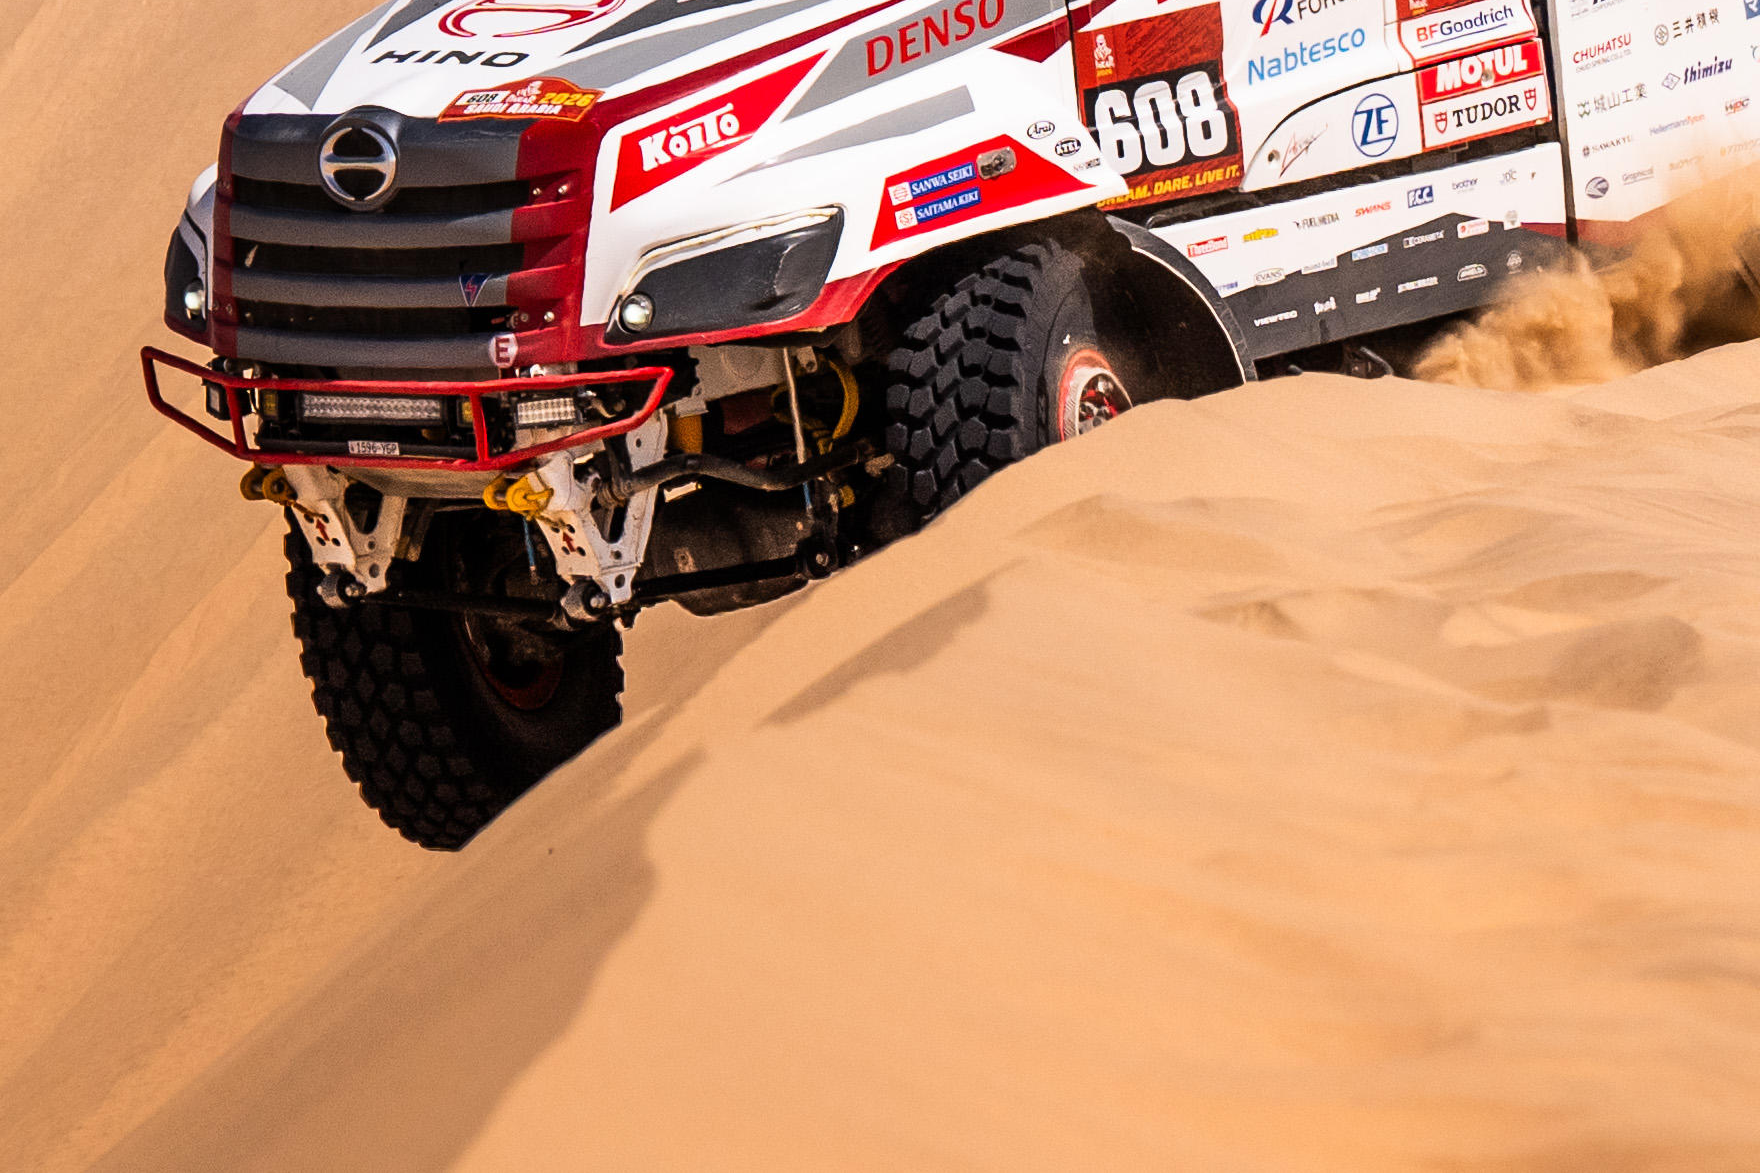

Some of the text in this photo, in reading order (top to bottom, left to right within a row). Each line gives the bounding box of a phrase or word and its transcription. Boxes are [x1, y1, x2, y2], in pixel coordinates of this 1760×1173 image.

[1416, 4, 1514, 43] BFGoodrich
[370, 49, 531, 68] HINO
[1247, 27, 1366, 86] Nabtesco
[1572, 32, 1632, 64] CHUHATSU
[1435, 44, 1528, 93] MOTUL
[1683, 55, 1733, 85] Shimizu
[463, 103, 509, 115] SAUDI
[538, 92, 595, 107] 2026
[1452, 94, 1521, 128] TUDOR
[1094, 70, 1228, 176] 608
[1354, 104, 1395, 146] ZF
[911, 164, 973, 196] SANWA SEIKI
[1153, 175, 1193, 196] DARE.
[1195, 169, 1225, 187] LIVE
[1224, 164, 1240, 179] IT.
[916, 190, 979, 219] SAITAMA KIKI
[1354, 201, 1392, 217] SWANS
[1256, 270, 1282, 282] EVANS
